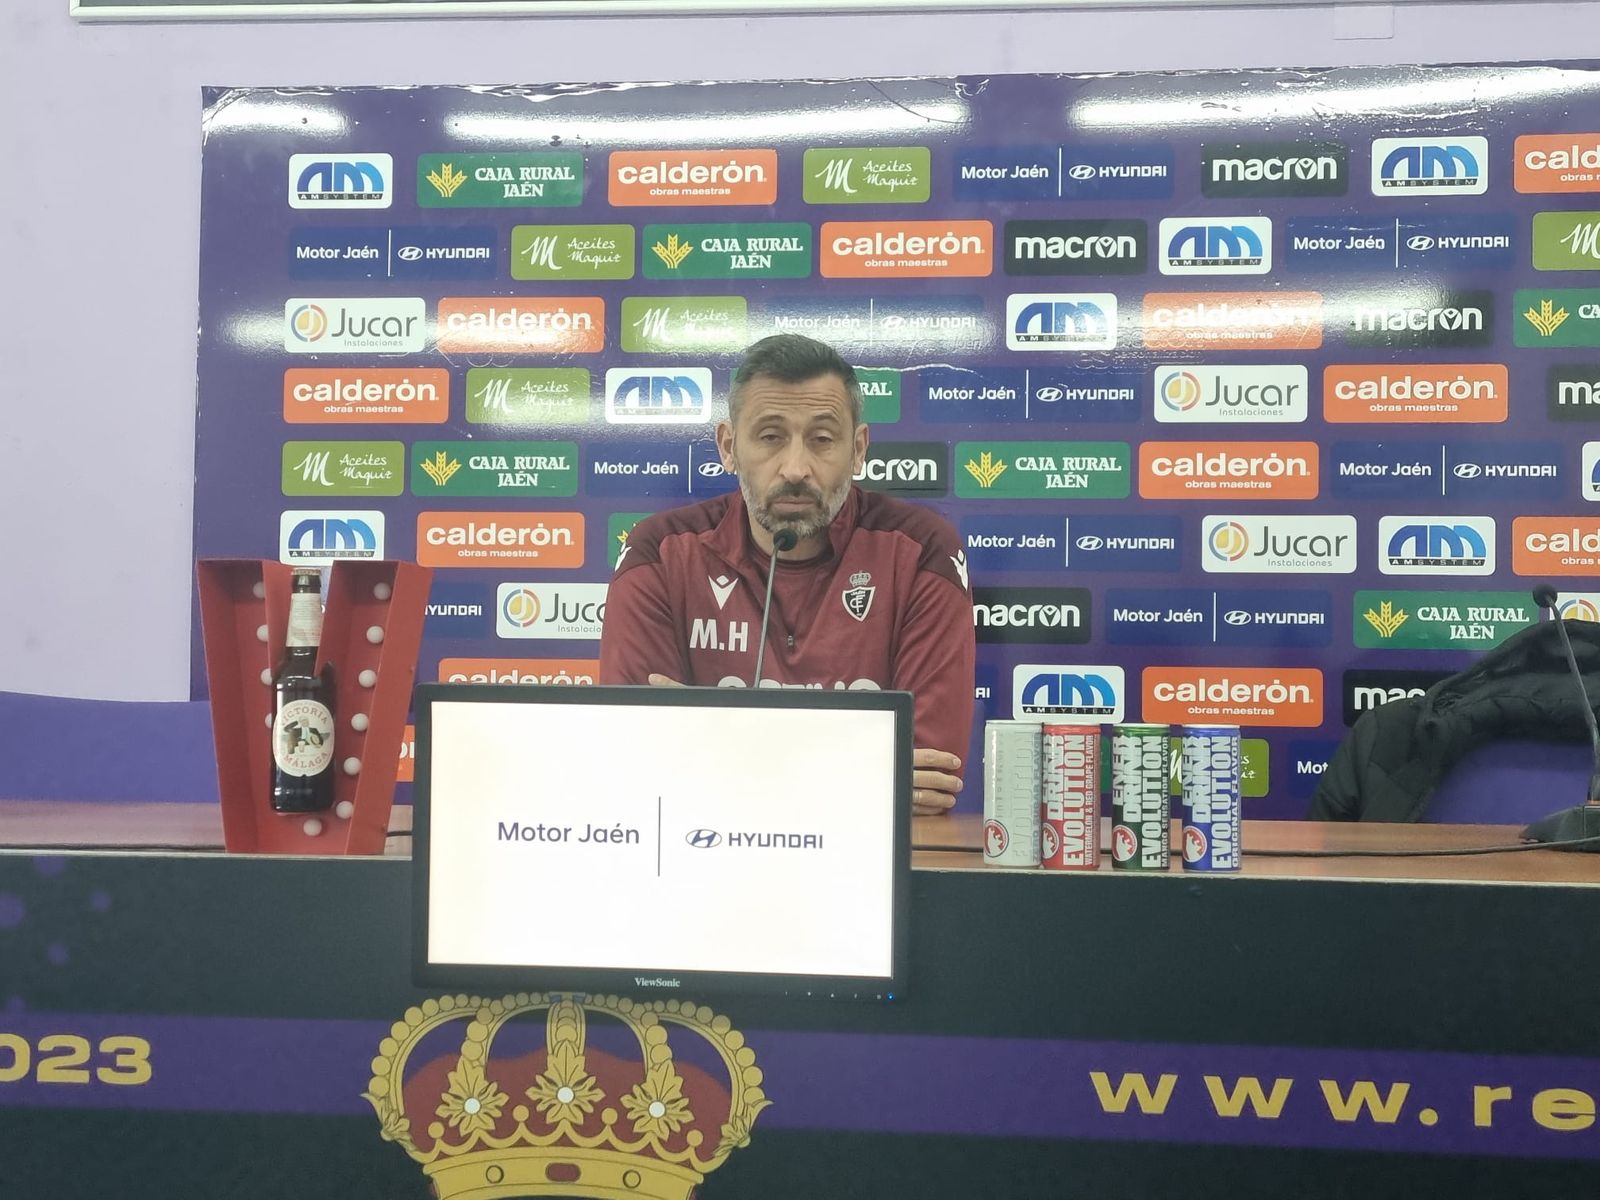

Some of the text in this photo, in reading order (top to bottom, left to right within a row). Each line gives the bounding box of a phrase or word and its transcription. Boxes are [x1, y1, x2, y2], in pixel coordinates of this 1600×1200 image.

[862, 160, 912, 172] Aceites
[961, 164, 1049, 179] Motor Jaén
[1099, 166, 1167, 177] HYUNDAI
[1212, 157, 1337, 181] macron
[474, 167, 575, 181] CAJA RURAL
[504, 182, 544, 198] JAÉN
[682, 188, 731, 196] maestras
[568, 238, 615, 250] Aceites
[701, 238, 803, 252] CAJA RURAL
[1014, 235, 1136, 259] macron
[1294, 235, 1385, 250] Motor Jaén
[1438, 236, 1509, 248] HYUNDAI
[296, 245, 379, 259] Motor Jaén
[426, 248, 489, 259] HYUNDAI
[730, 252, 772, 269] JAÉN
[865, 259, 895, 267] obras
[331, 308, 417, 338] Jucar
[680, 310, 728, 322] Aceites
[774, 315, 860, 328] Motor Jaén
[909, 317, 976, 328] HYUNDAI
[1354, 307, 1482, 331] macron
[520, 380, 569, 393] Aceites
[929, 386, 1015, 400] Motor Jaén
[1205, 376, 1299, 407] Jucar
[1067, 389, 1133, 400] HYUNDAI
[324, 405, 404, 414] obras maestras
[1220, 408, 1283, 416] Instalaciones
[1369, 404, 1458, 412] obras maestras
[340, 454, 387, 466] Aceites
[469, 456, 570, 470] CAJA RURAL
[1015, 457, 1121, 471] CAJA RURAL
[594, 460, 679, 475] Motor Jaén
[1340, 461, 1432, 476] Motor Jaén
[1485, 465, 1556, 477] HYUNDAI
[498, 471, 539, 487] JAÉN
[1046, 471, 1088, 488] JAÉN
[968, 534, 1056, 548] Motor Jaén
[1107, 538, 1174, 549] HYUNDAI
[1254, 526, 1348, 557] Jucar
[457, 550, 538, 558] obras maestras
[1561, 557, 1594, 565] obras
[1268, 559, 1333, 567] Instalaciones
[1113, 608, 1203, 622] Motor Jaén
[1255, 613, 1324, 624] HYUNDAI
[1417, 607, 1529, 622] CAJA RURAL
[689, 619, 749, 652] M.H
[1449, 623, 1495, 640] JAÉN
[1188, 706, 1275, 715] obras maestras
[1085, 735, 1093, 763] FLAVOR
[1085, 765, 1093, 789] GRAPE
[1064, 735, 1085, 865] EVOLUTION
[1142, 736, 1161, 867] EVOLUTION
[1212, 736, 1231, 868] EVOLUTION
[498, 822, 640, 844] Motor Jaén
[1085, 815, 1093, 865] WATERMELON
[728, 832, 823, 849] HYUNDAI
[634, 978, 681, 988] ViewSonic
